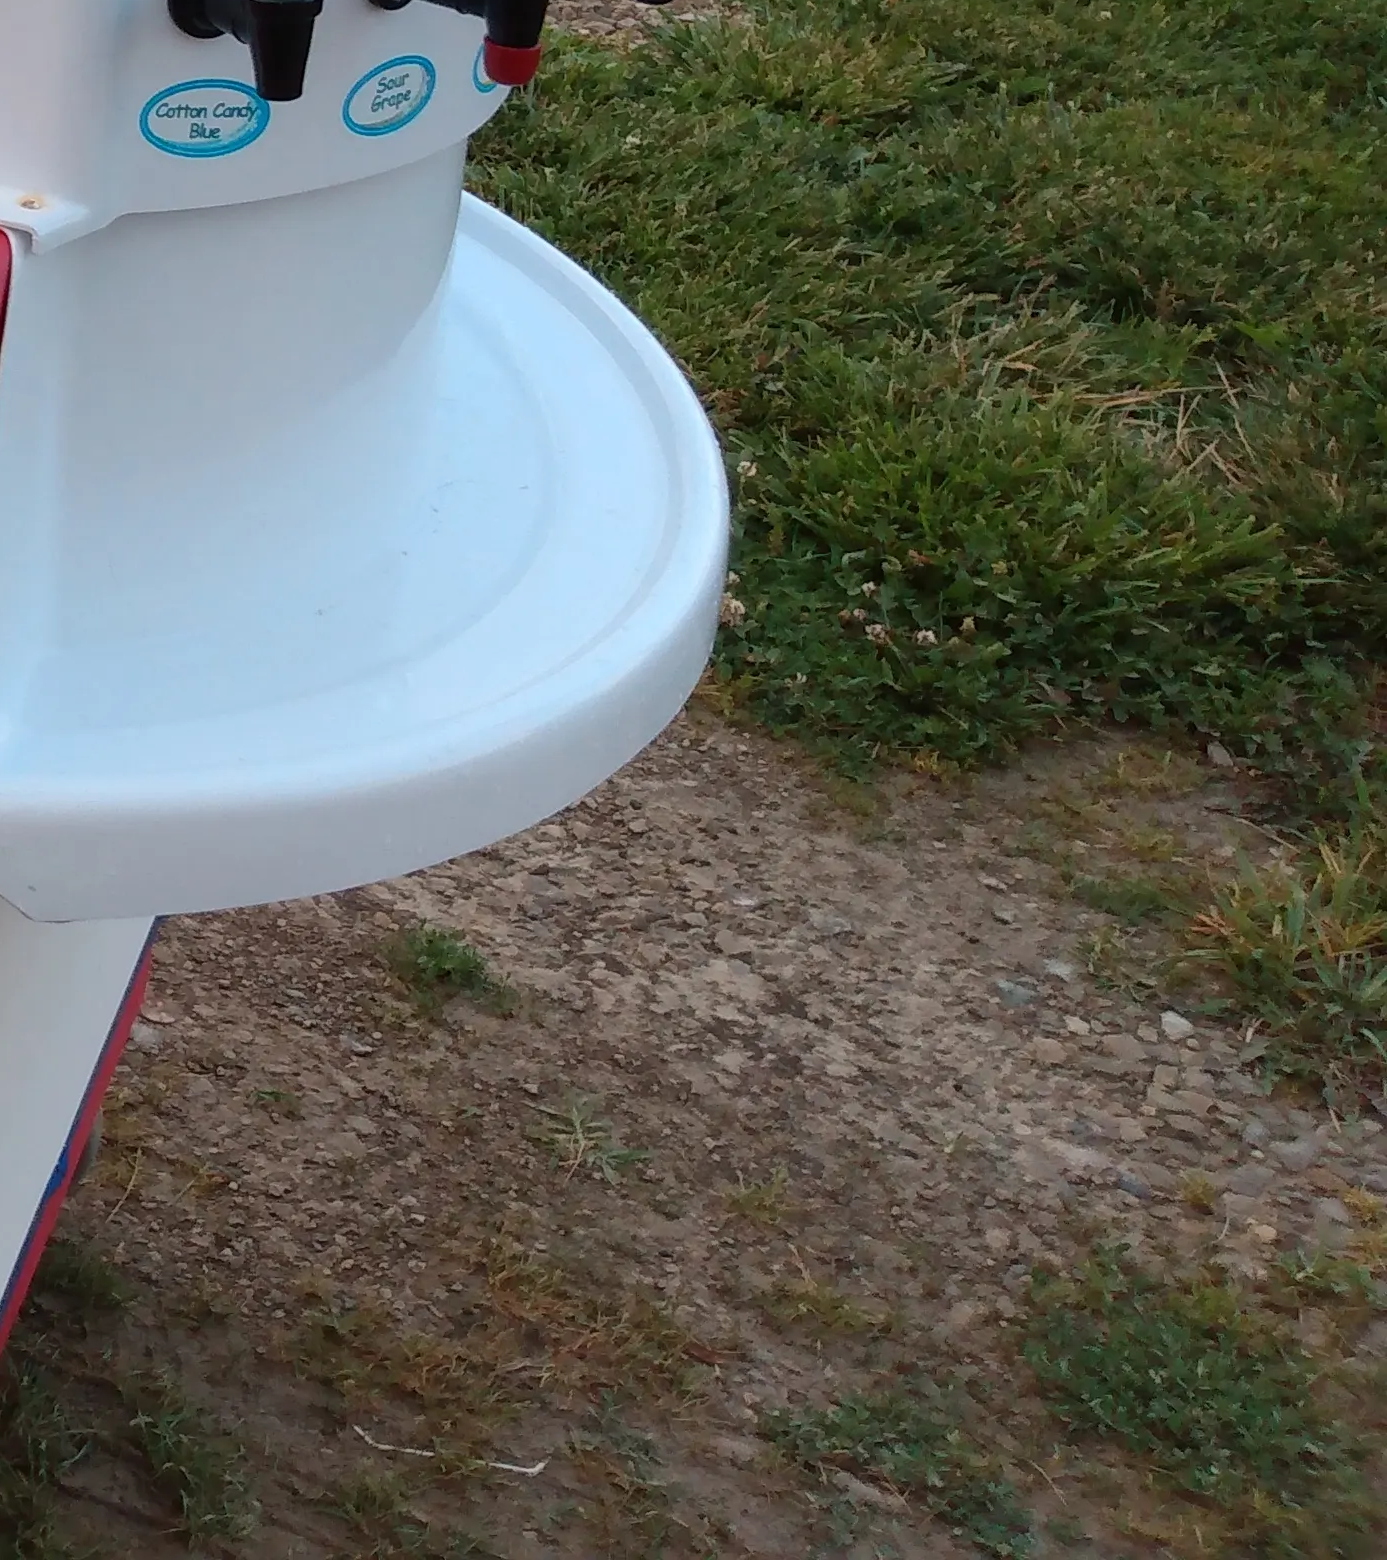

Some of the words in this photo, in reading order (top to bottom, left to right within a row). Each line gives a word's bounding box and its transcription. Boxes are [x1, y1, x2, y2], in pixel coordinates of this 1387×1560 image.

[377, 73, 410, 93] Sour
[371, 90, 411, 112] Grape
[156, 102, 207, 119] Cotton
[212, 103, 256, 121] Candy
[189, 123, 220, 139] Blue
